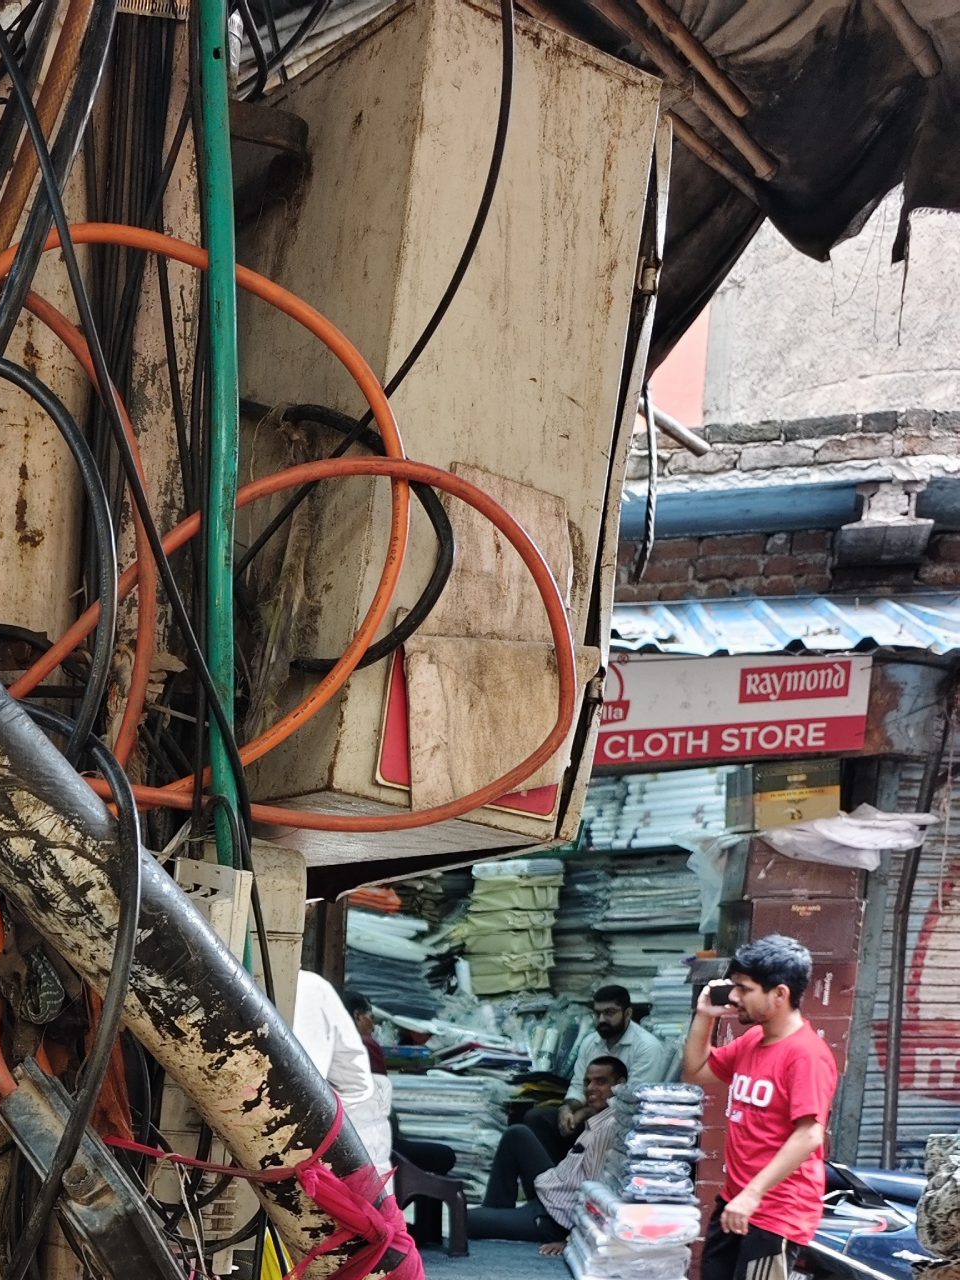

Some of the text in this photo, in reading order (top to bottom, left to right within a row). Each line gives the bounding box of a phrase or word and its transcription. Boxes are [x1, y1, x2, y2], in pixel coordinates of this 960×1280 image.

[745, 662, 846, 700] Raymond
[603, 722, 828, 760] CLOTH STORE
